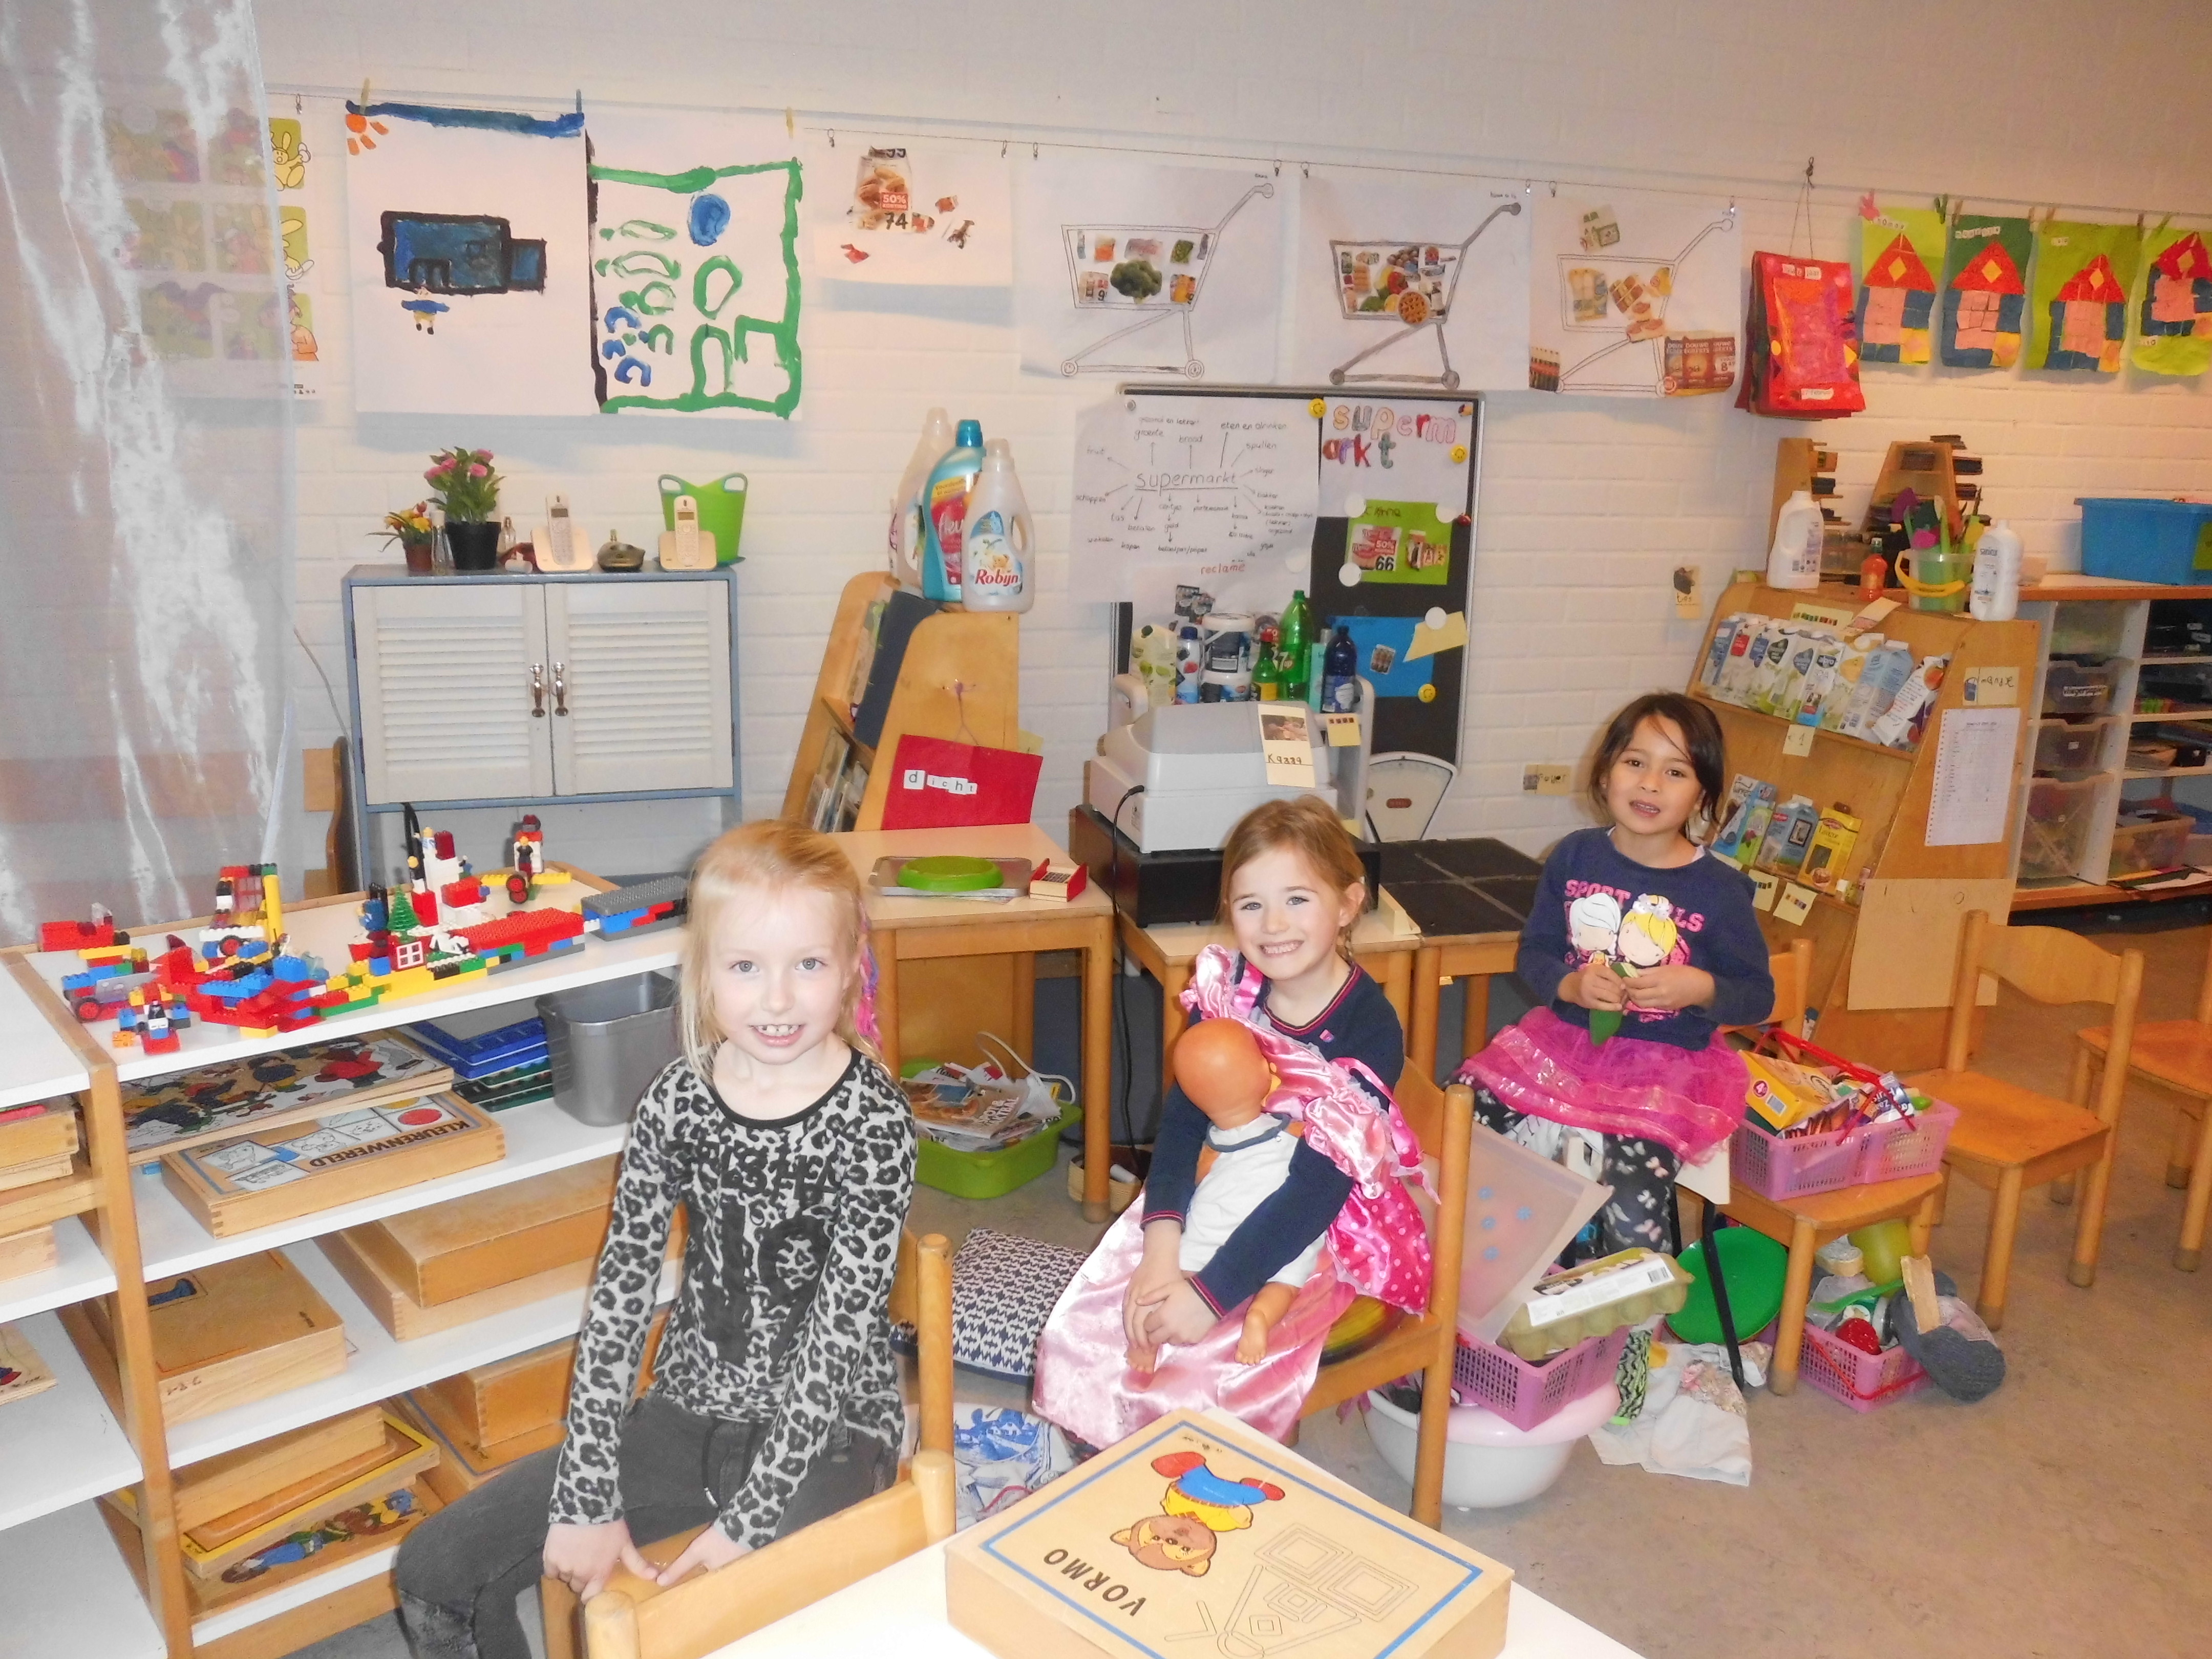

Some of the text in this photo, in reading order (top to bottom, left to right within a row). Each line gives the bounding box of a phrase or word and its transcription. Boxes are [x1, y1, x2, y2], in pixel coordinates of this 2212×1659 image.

[882, 193, 907, 204] 50%
[884, 211, 908, 230] 74
[1135, 471, 1237, 496] supermarkt
[1200, 563, 1245, 575] reclame
[1375, 555, 1395, 571] 66
[975, 568, 1019, 587] Robijn
[908, 771, 973, 793] dicht
[309, 1121, 470, 1167] KLEURENWERELD
[1044, 1548, 1146, 1617] VORMO
